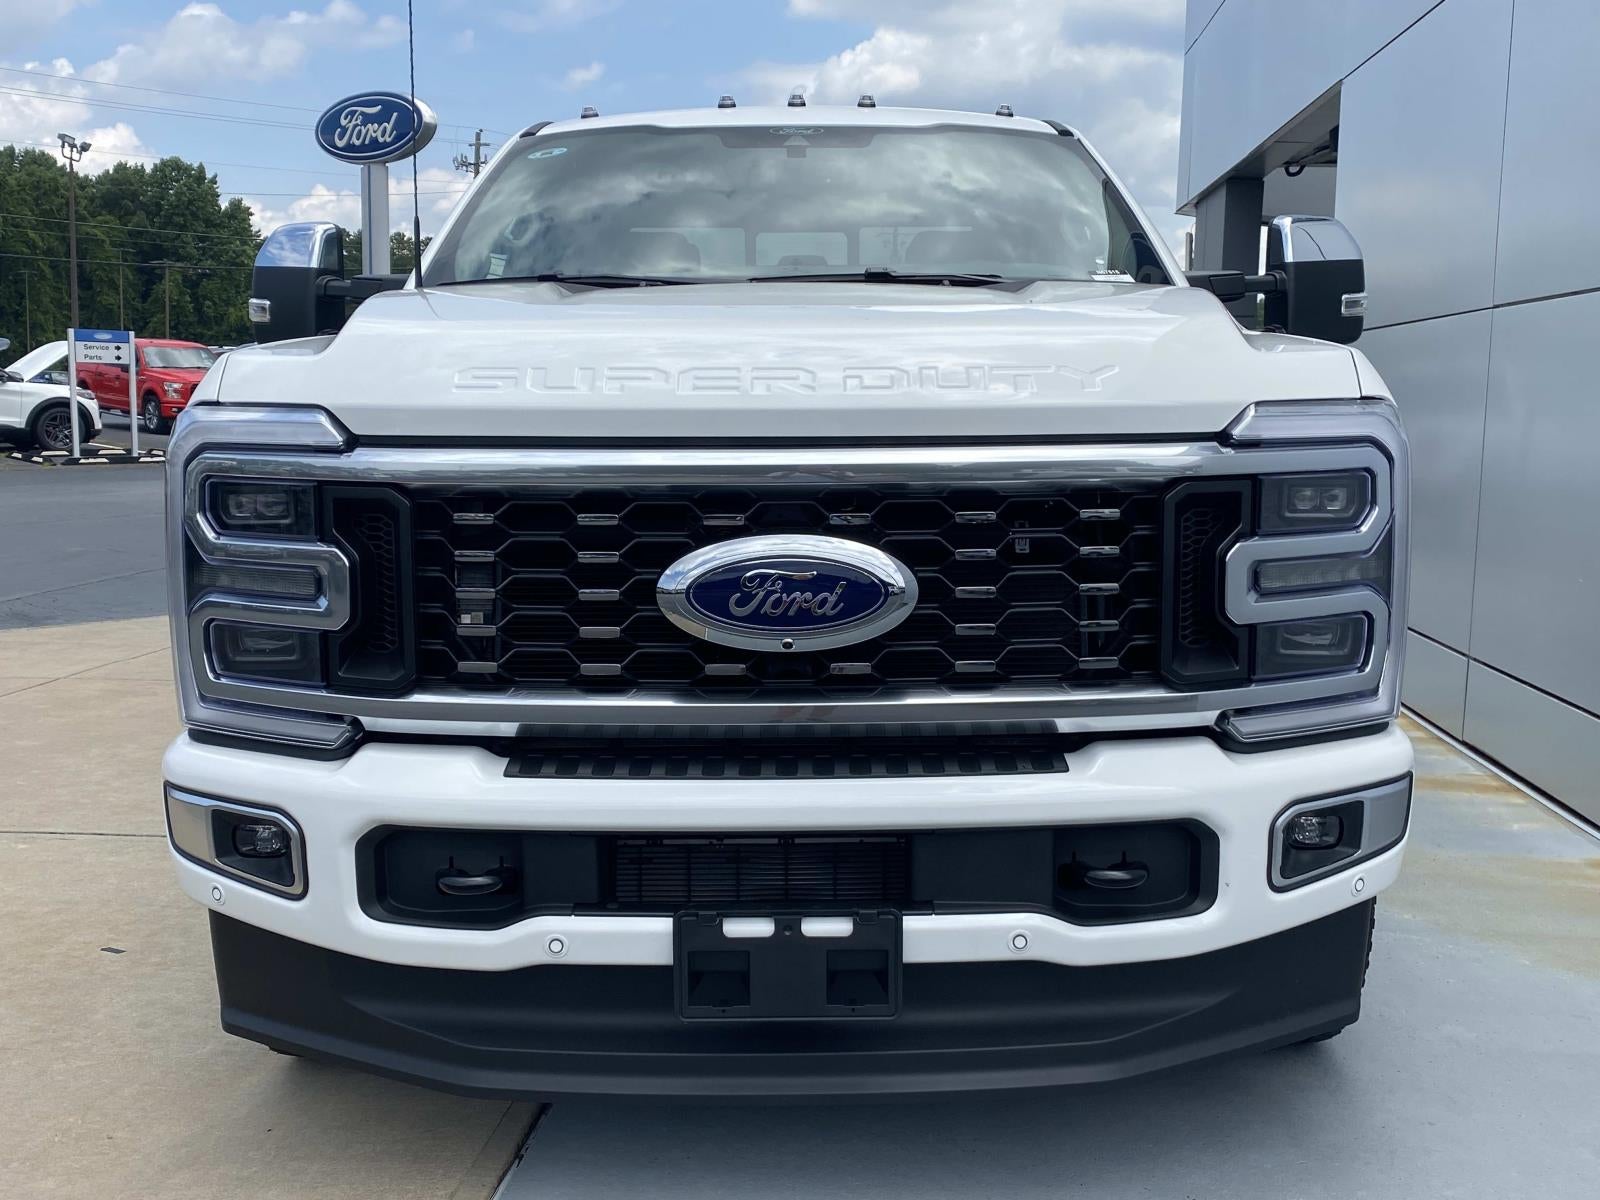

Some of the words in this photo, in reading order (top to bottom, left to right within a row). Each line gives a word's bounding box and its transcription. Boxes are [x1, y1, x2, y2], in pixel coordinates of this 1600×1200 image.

[334, 105, 398, 147] Ford
[83, 343, 110, 351] Service
[83, 353, 103, 361] Parts
[452, 366, 817, 395] SUPER
[843, 365, 1120, 394] DUTY
[728, 568, 847, 617] Ford
